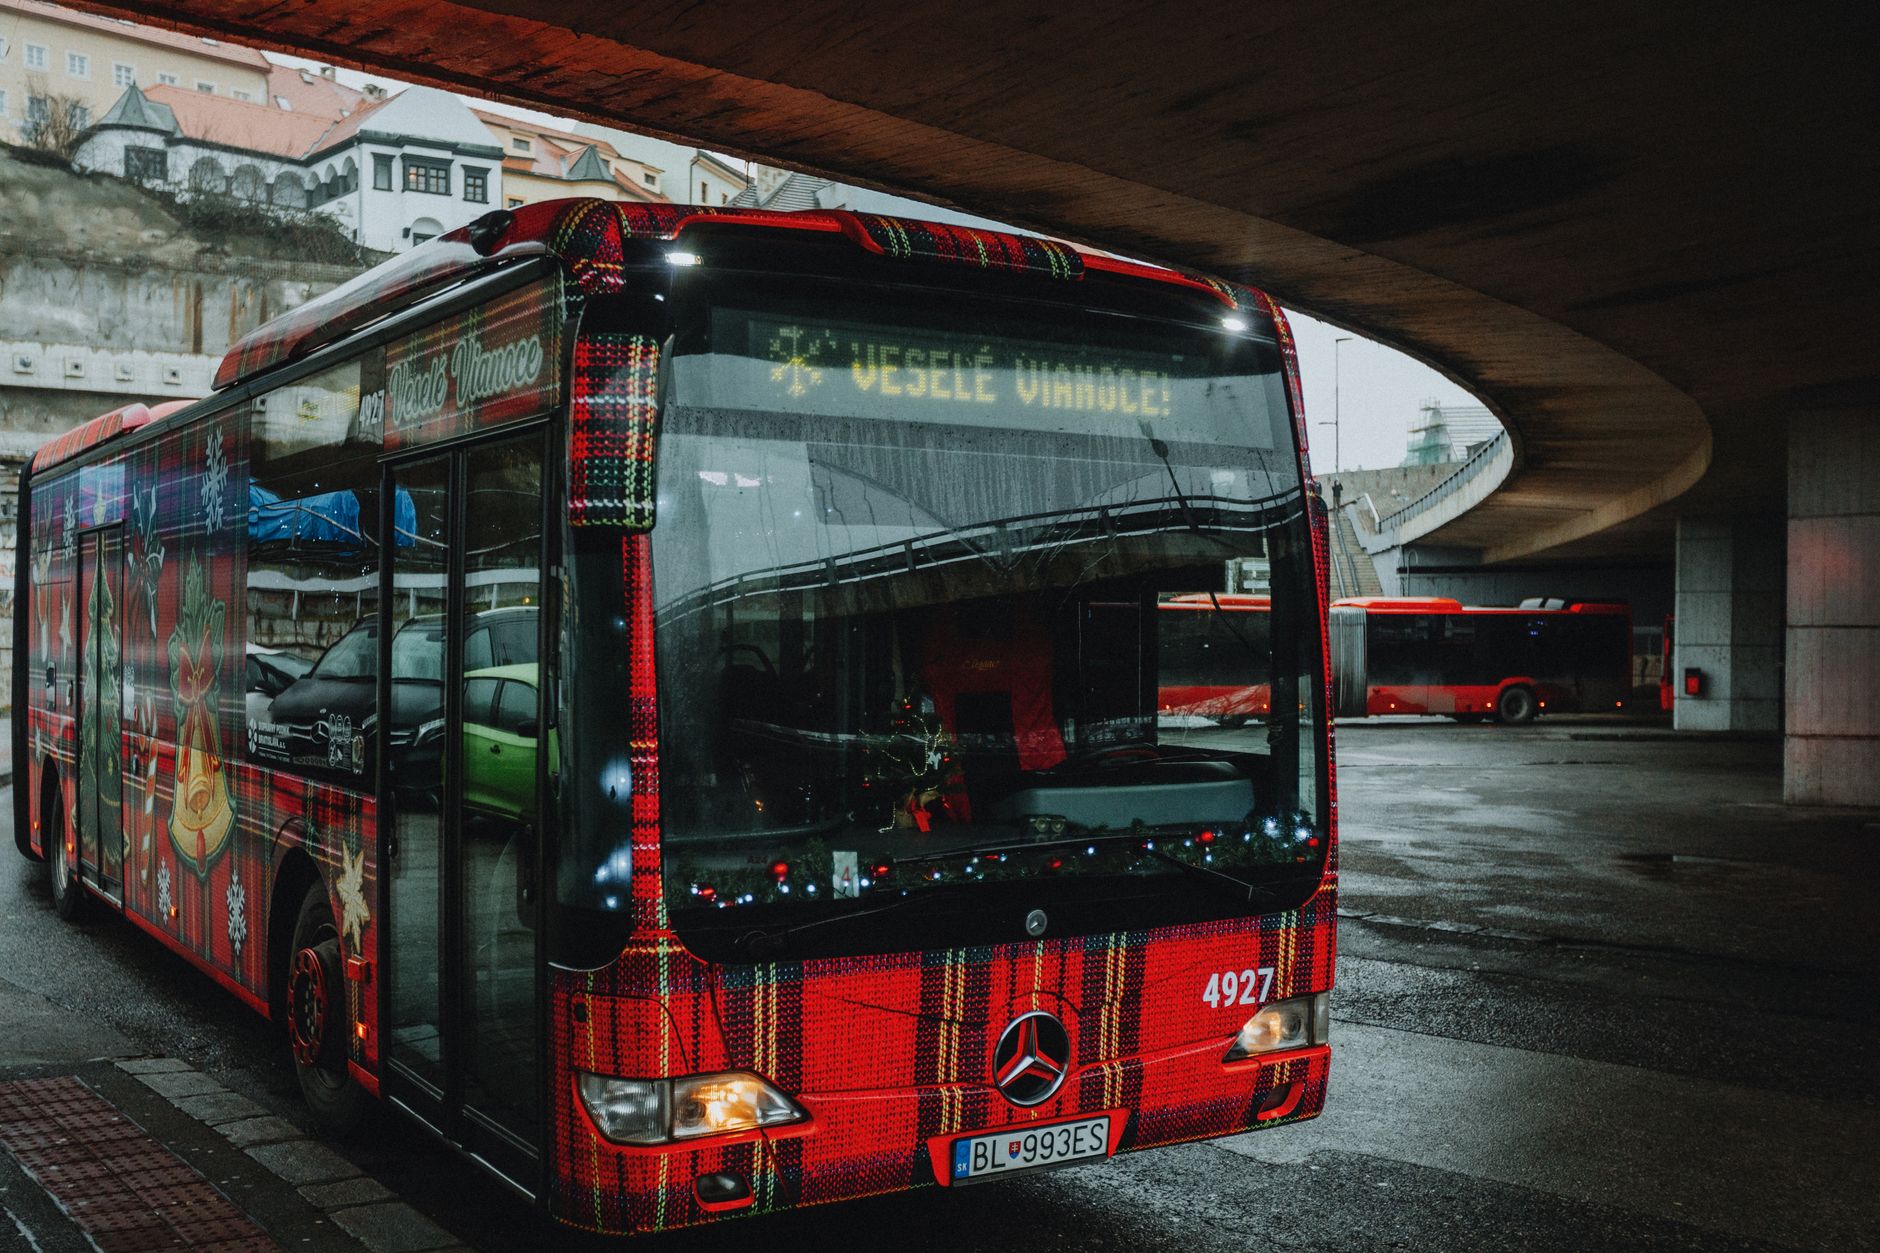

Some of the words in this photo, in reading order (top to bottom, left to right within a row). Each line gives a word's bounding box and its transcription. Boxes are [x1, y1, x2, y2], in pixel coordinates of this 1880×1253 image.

[388, 352, 449, 427] Veselé
[451, 334, 544, 408] Vianoce
[851, 342, 997, 403] VESELÉ
[359, 389, 385, 428] 4927
[1202, 967, 1275, 1009] 4927
[957, 1163, 967, 1172] SK
[973, 1140, 1006, 1172] BL
[1023, 1123, 1105, 1163] 993ES
